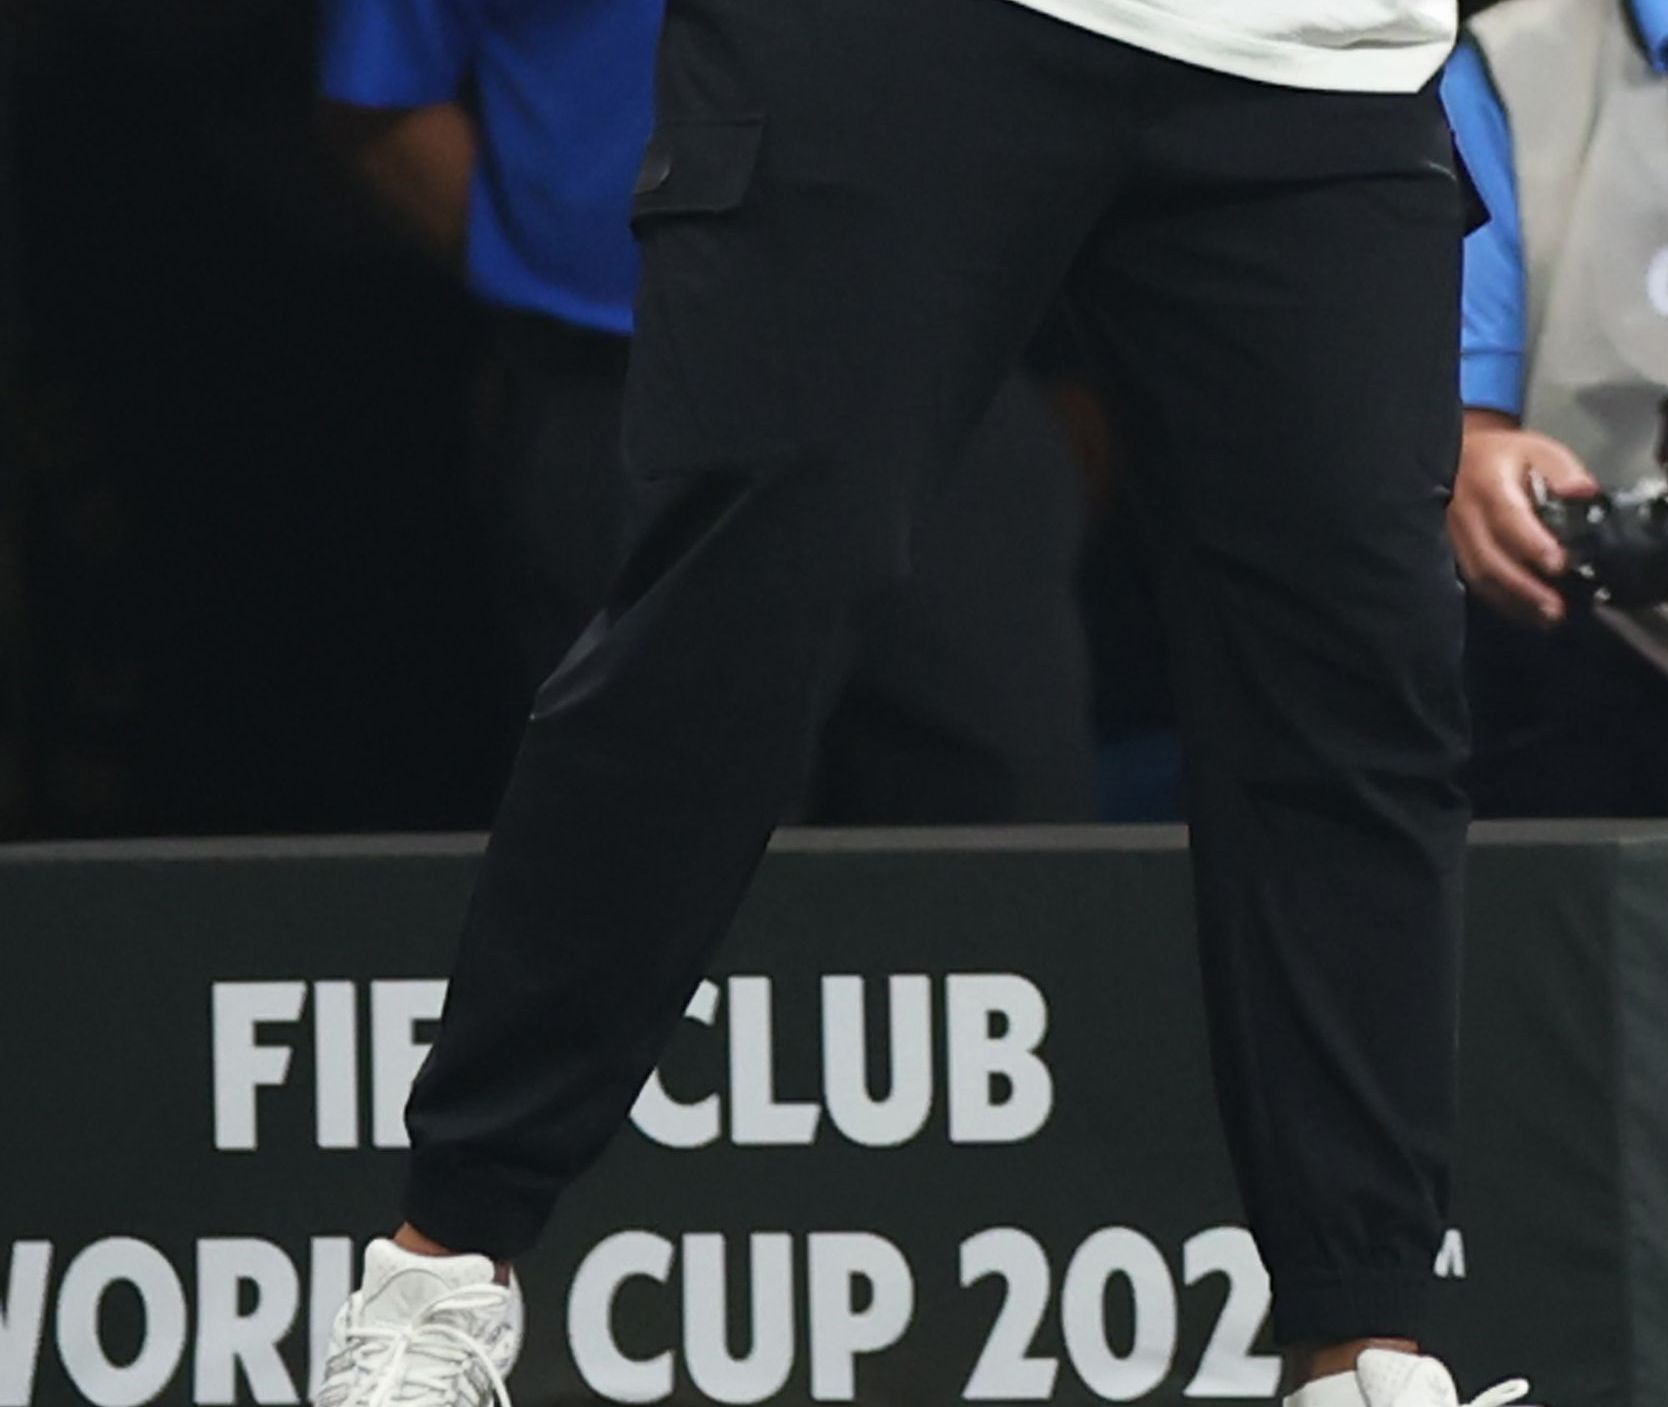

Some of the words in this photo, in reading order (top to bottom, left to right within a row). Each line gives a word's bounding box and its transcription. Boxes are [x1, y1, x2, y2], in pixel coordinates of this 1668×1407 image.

[210, 978, 451, 1150] FIF
[567, 1231, 914, 1404] CUP
[959, 1225, 1284, 1402] 202
